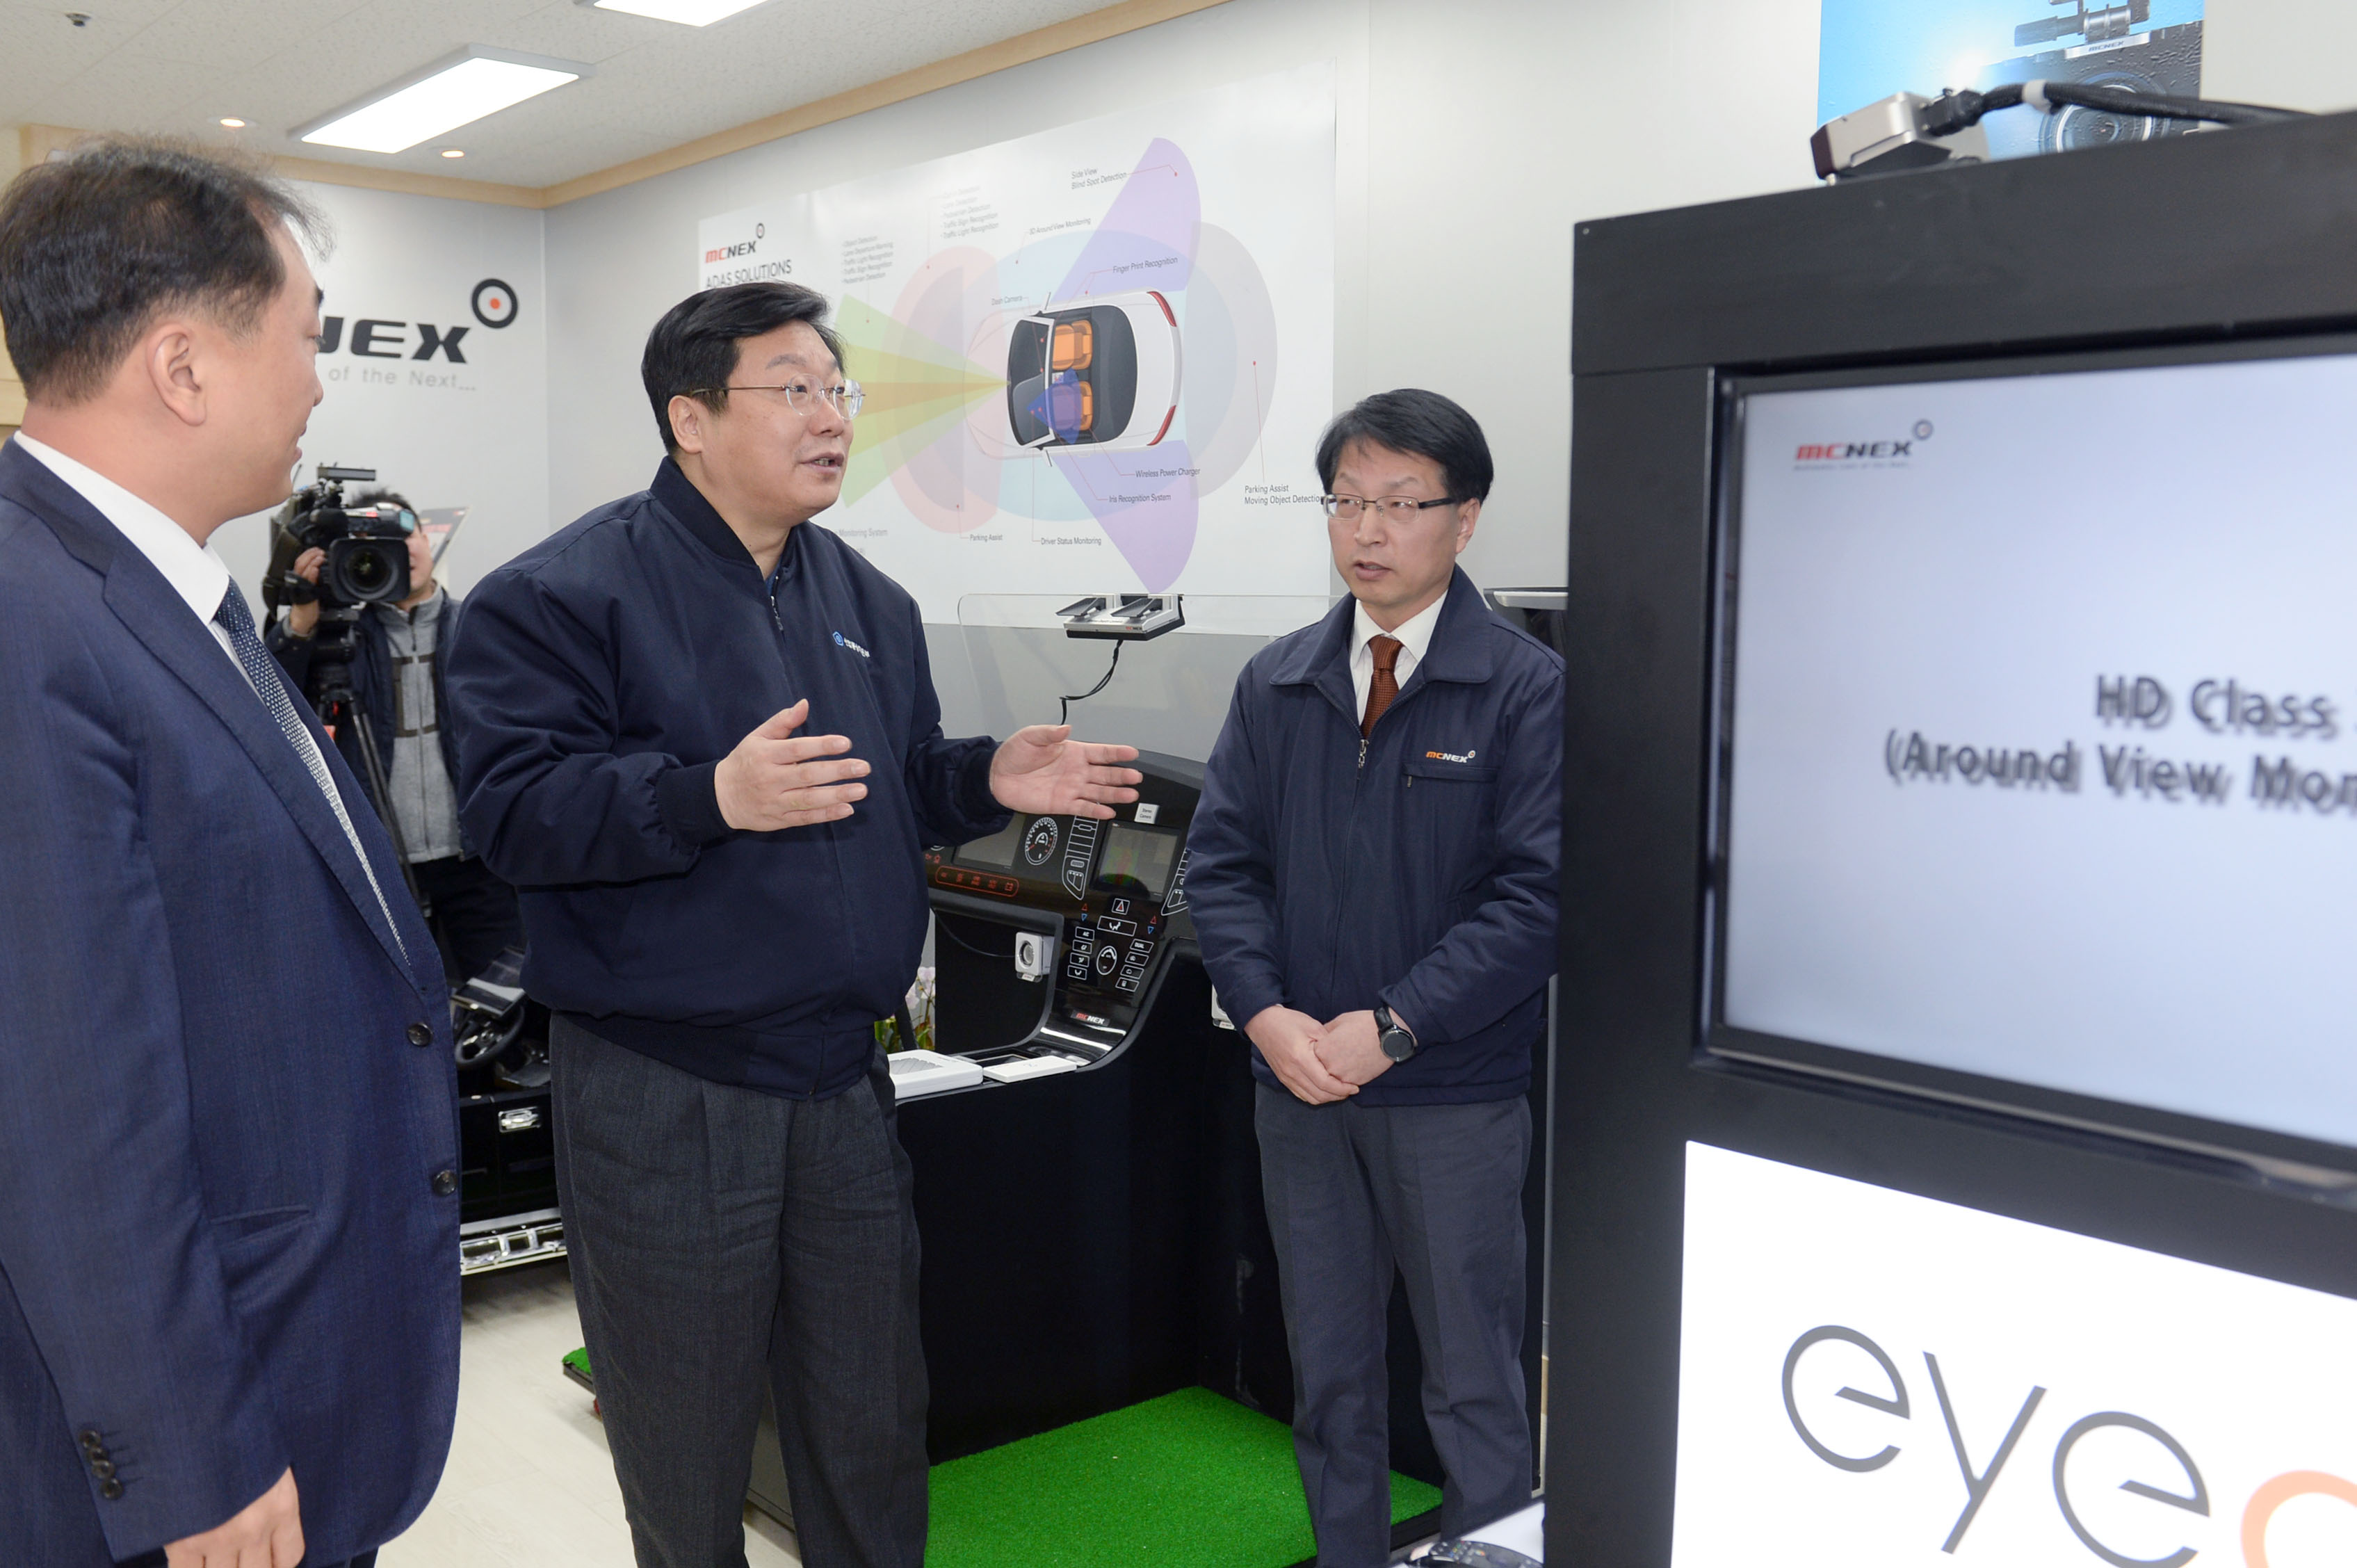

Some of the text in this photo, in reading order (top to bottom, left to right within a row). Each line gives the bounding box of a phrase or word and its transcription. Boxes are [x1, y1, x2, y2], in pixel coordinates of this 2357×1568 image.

[1071, 170, 1084, 179] Side
[1071, 172, 1128, 190] Blind Spot Detection
[970, 212, 998, 223] Recognition
[971, 223, 999, 233] Recognition
[1053, 222, 1064, 230] View
[1065, 218, 1091, 228] Monitoring
[1112, 257, 1178, 274] Finger Print Recognition
[706, 259, 792, 288] ADAS SOLUTIONS
[1004, 295, 1023, 304] Camera
[328, 366, 350, 382] of
[362, 368, 398, 385] the
[1135, 467, 1201, 478] Wireless Power Charger
[1245, 484, 1289, 494] Parking Assist
[1118, 494, 1150, 503] Recognition
[1151, 493, 1172, 502] System
[1244, 494, 1322, 506] Moving Object Detectio
[970, 533, 988, 542] Parking
[1057, 537, 1073, 545] Status
[1074, 537, 1102, 546] Monitoring
[2095, 674, 2171, 728] HD
[2189, 678, 2338, 738] Class
[1885, 728, 2080, 793] (Around
[2098, 743, 2230, 803] View
